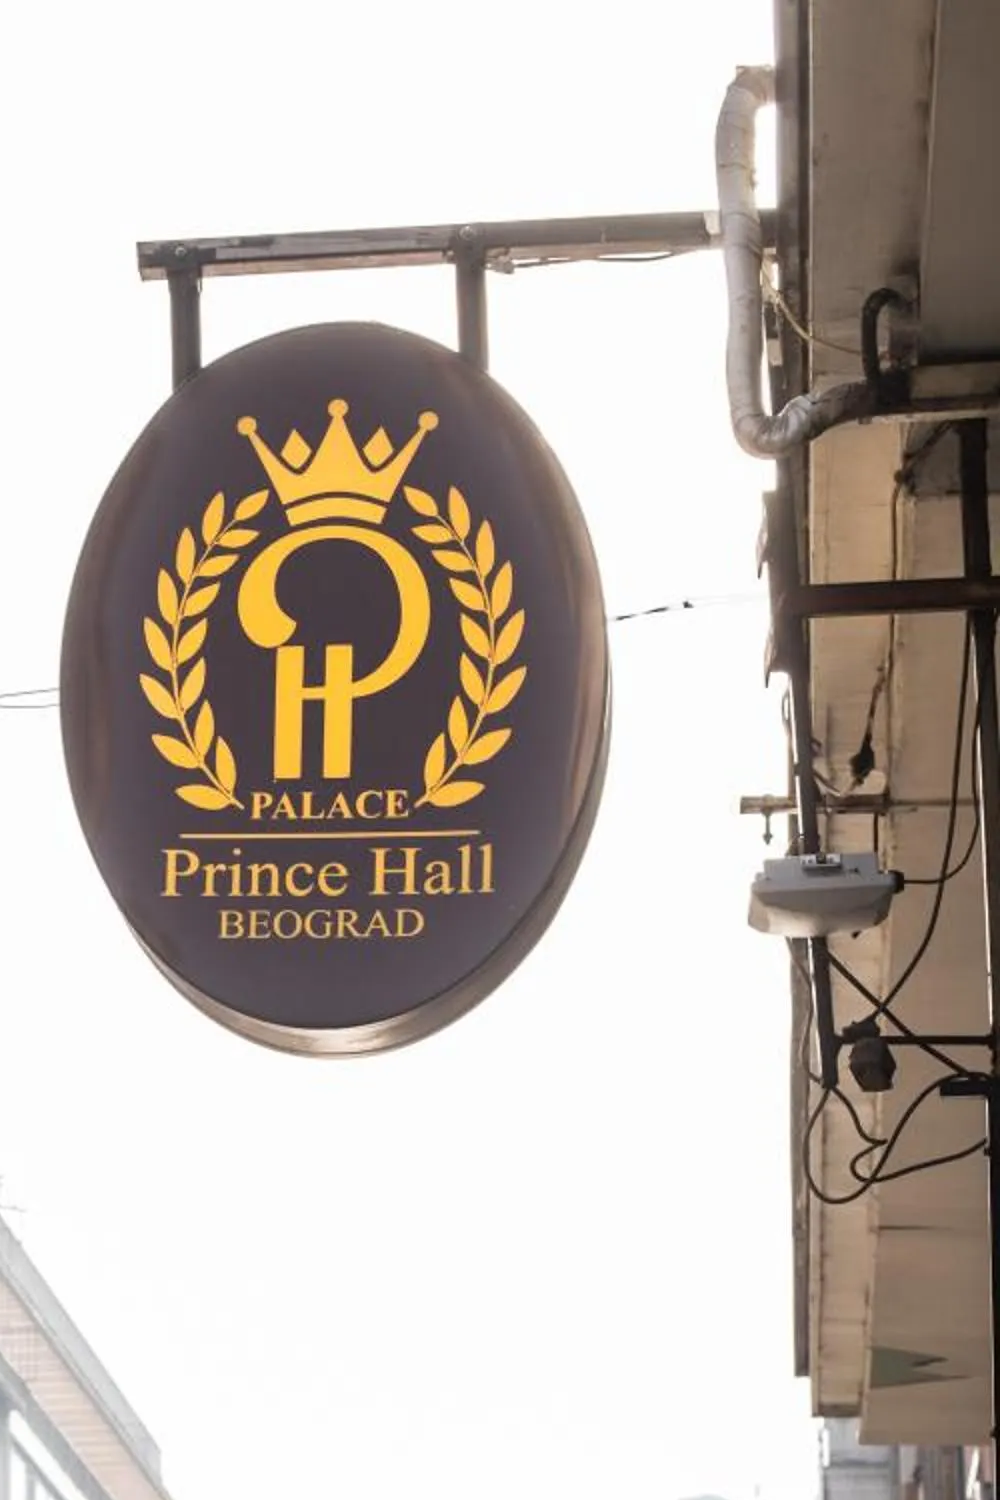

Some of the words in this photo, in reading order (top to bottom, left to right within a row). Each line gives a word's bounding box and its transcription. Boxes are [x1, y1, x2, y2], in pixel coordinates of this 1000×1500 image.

[250, 788, 410, 821] PALACE
[160, 846, 350, 898] Prince
[369, 843, 496, 896] Hall
[218, 908, 426, 940] BEOGRAD
